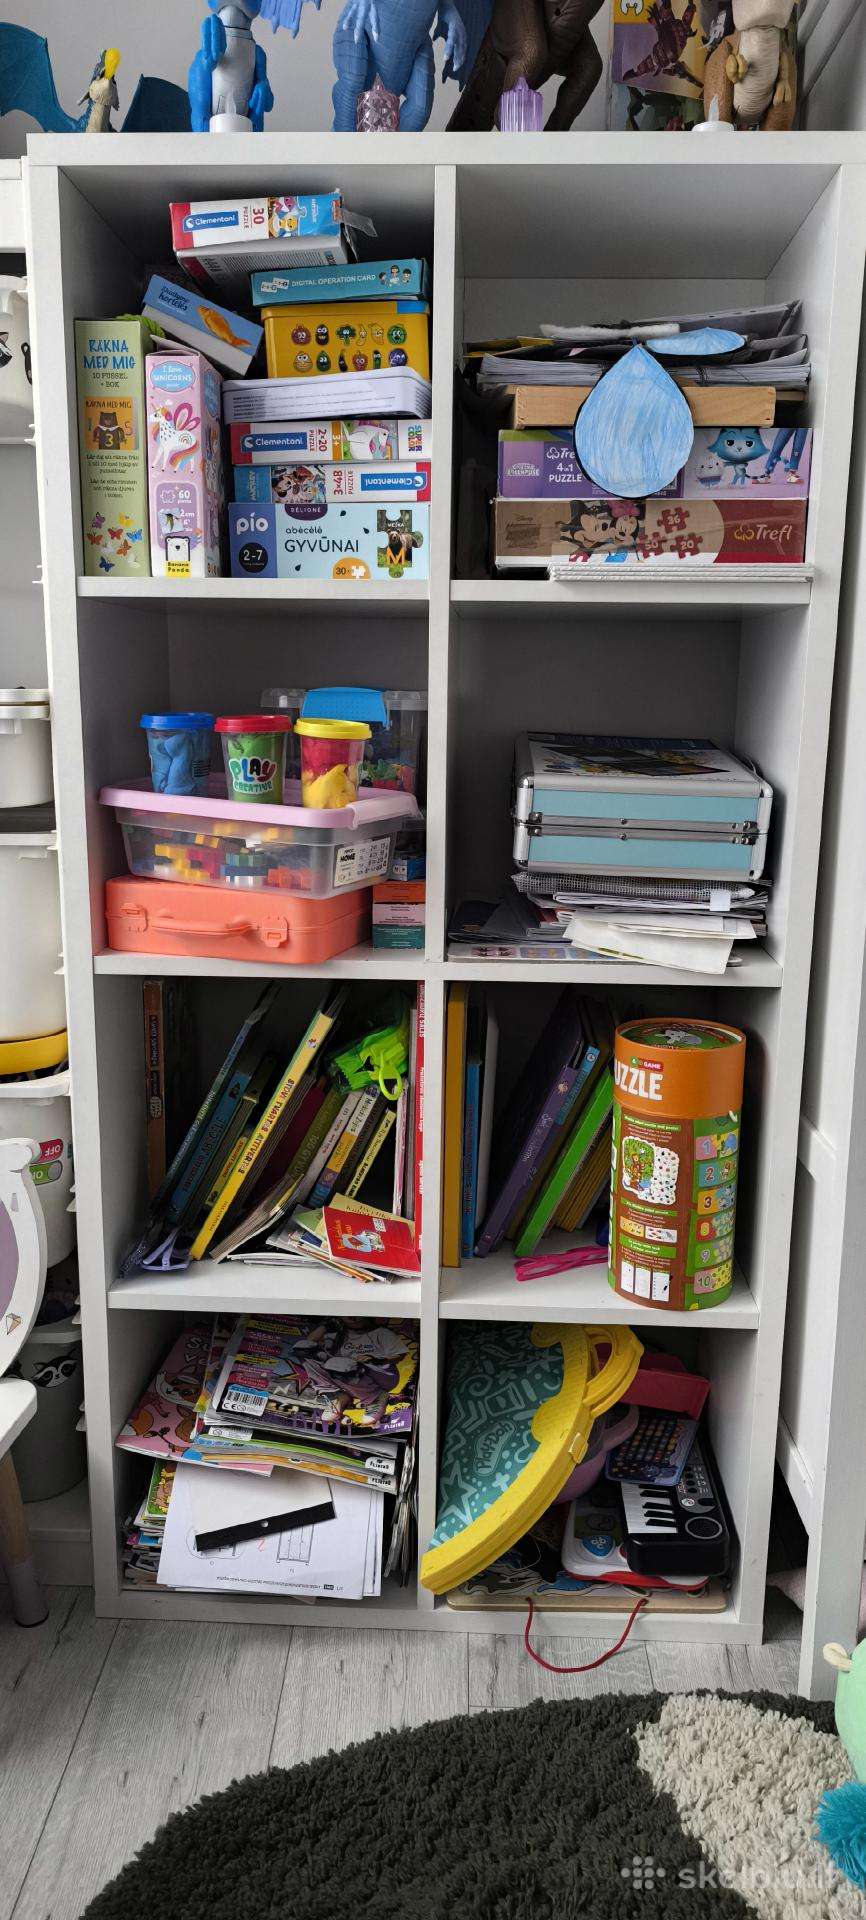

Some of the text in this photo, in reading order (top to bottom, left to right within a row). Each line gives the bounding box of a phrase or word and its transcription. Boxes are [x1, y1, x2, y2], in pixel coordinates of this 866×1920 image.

[195, 214, 236, 226] Clementoni
[253, 207, 265, 225] 30
[319, 276, 353, 285] OPERATION
[83, 355, 136, 369] MED MIG
[105, 433, 113, 447] 3
[255, 437, 303, 446] Clementoni
[560, 447, 576, 459] Tre
[365, 477, 413, 487] Clementoni
[548, 474, 583, 482] PUZZLE
[178, 490, 190, 499] 60
[236, 511, 269, 535] pio
[667, 514, 681, 524] 36
[755, 523, 793, 543] Trefl
[284, 536, 359, 553] GYVŪNAI
[645, 540, 659, 549] 50
[680, 539, 694, 549] 20
[243, 549, 263, 561] 2-7
[386, 546, 405, 565] M
[335, 567, 346, 575] 30
[229, 757, 277, 783] PLAY
[233, 780, 273, 792] CREATIVE
[643, 1061, 662, 1070] GAME
[614, 1058, 663, 1101] UZZLE
[44, 1144, 60, 1157] OFF
[703, 1139, 711, 1154] 1
[705, 1166, 714, 1181] 2
[704, 1195, 712, 1209] 3
[698, 1275, 711, 1287] 10
